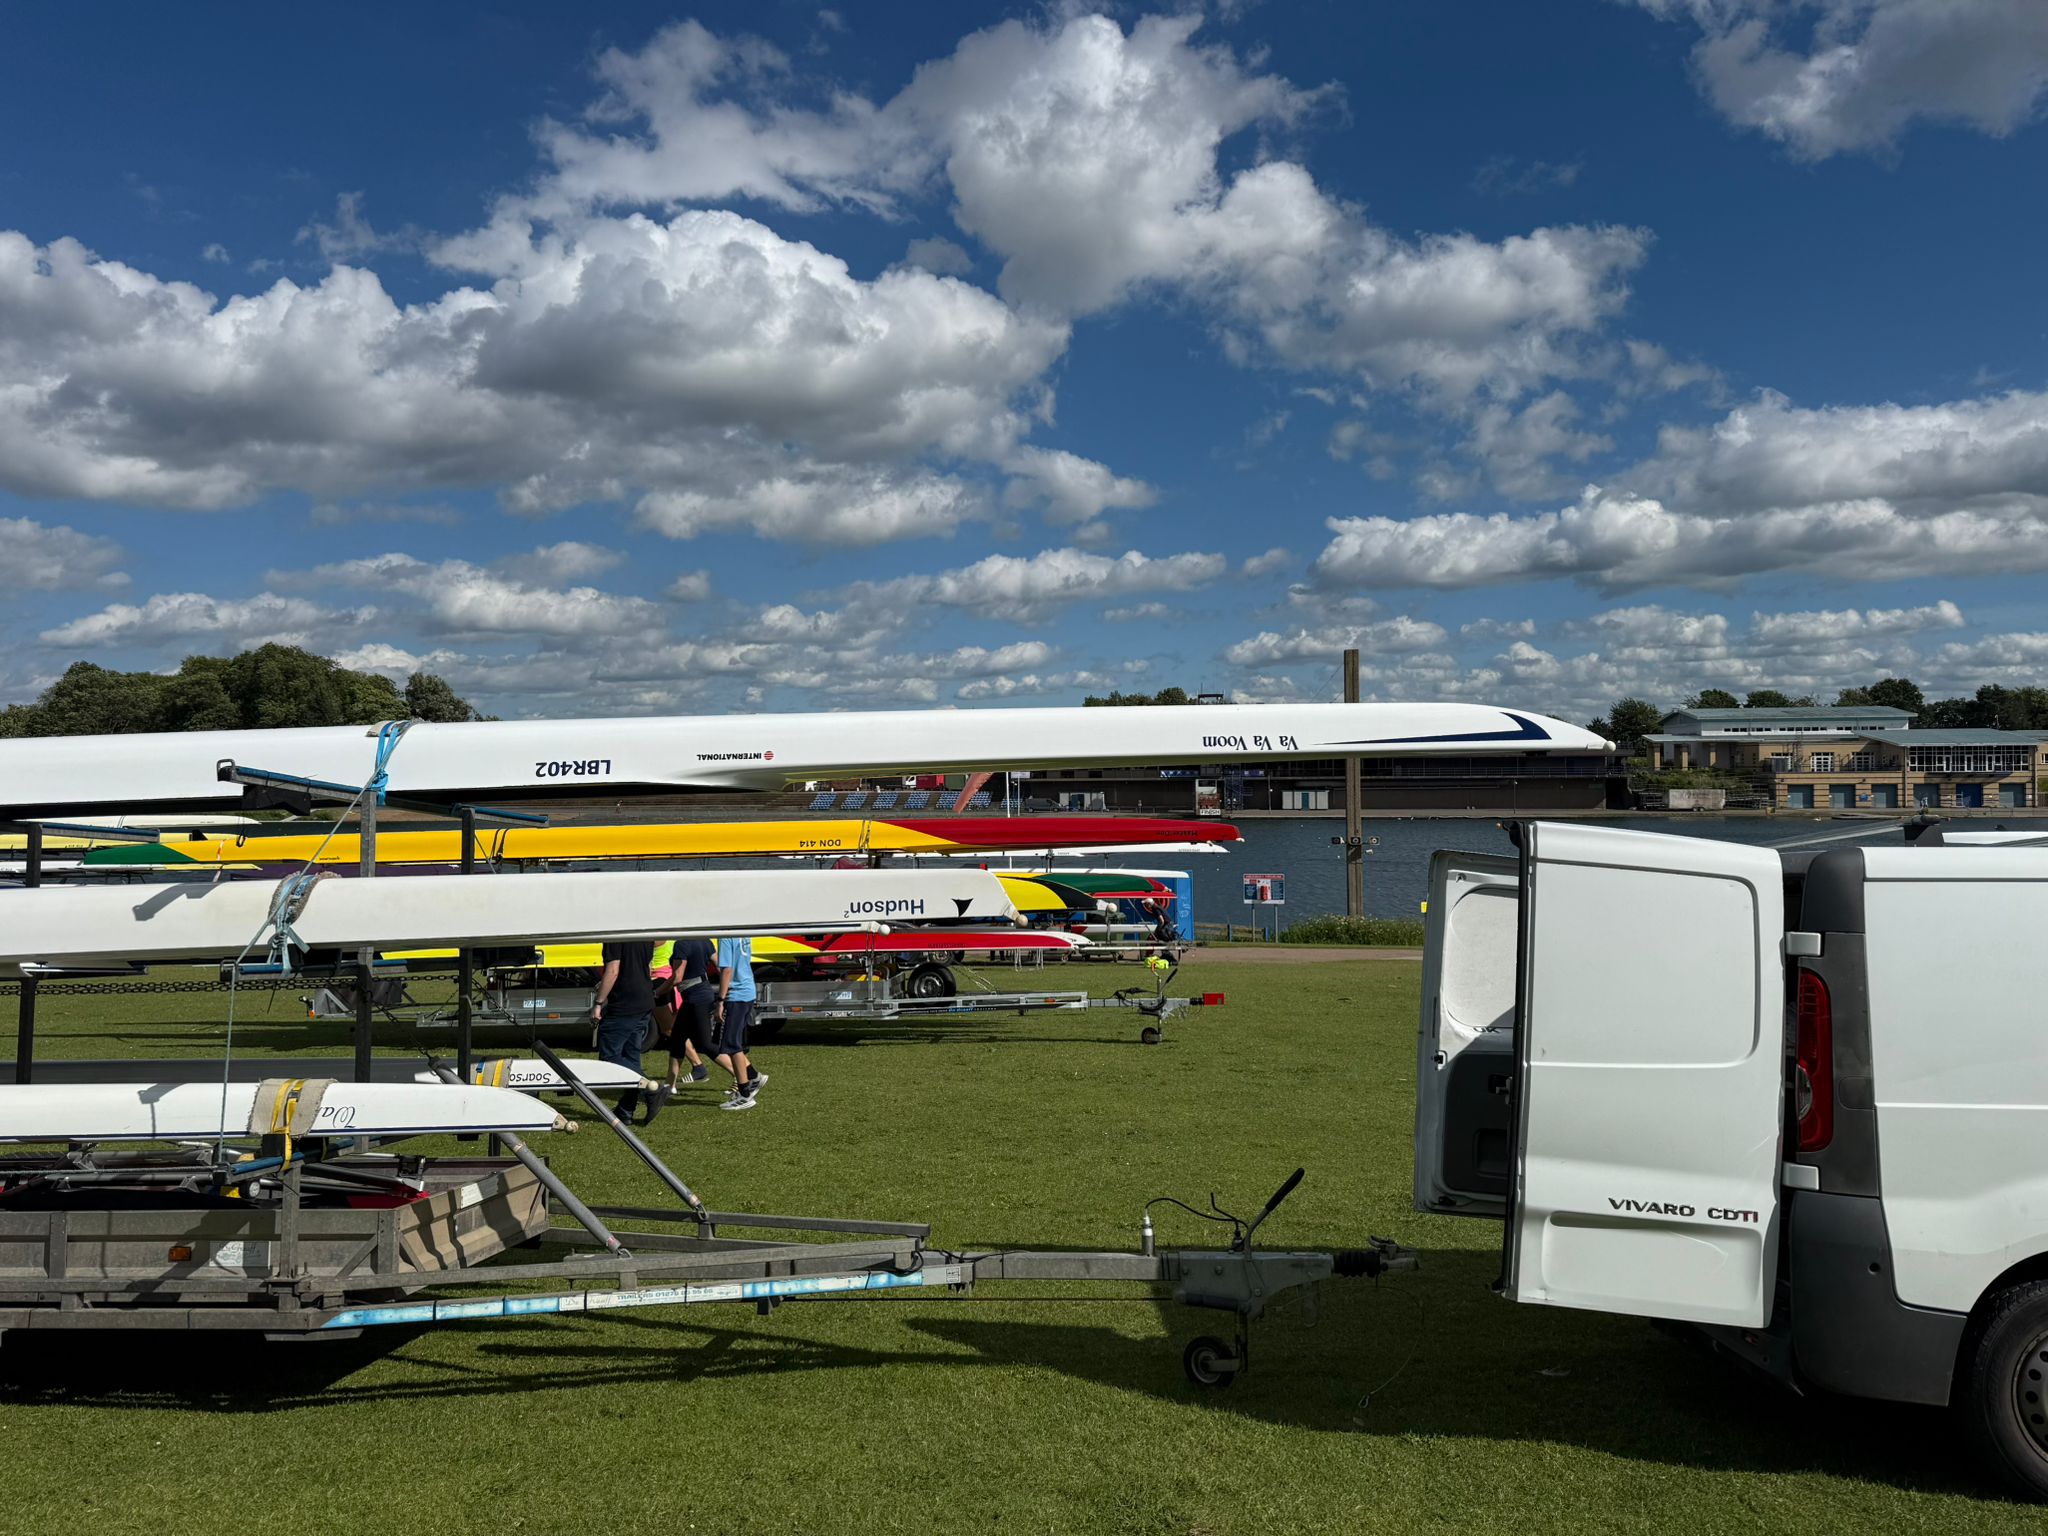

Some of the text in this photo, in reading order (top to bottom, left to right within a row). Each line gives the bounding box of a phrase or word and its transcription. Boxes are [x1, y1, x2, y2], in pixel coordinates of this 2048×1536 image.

[1202, 736, 1299, 750] Va Va Voom
[697, 752, 763, 761] INTERNATIONAL
[535, 760, 611, 778] LBR402
[799, 839, 841, 848] DON 414
[1607, 1197, 1759, 1223] VIVARO CDTI
